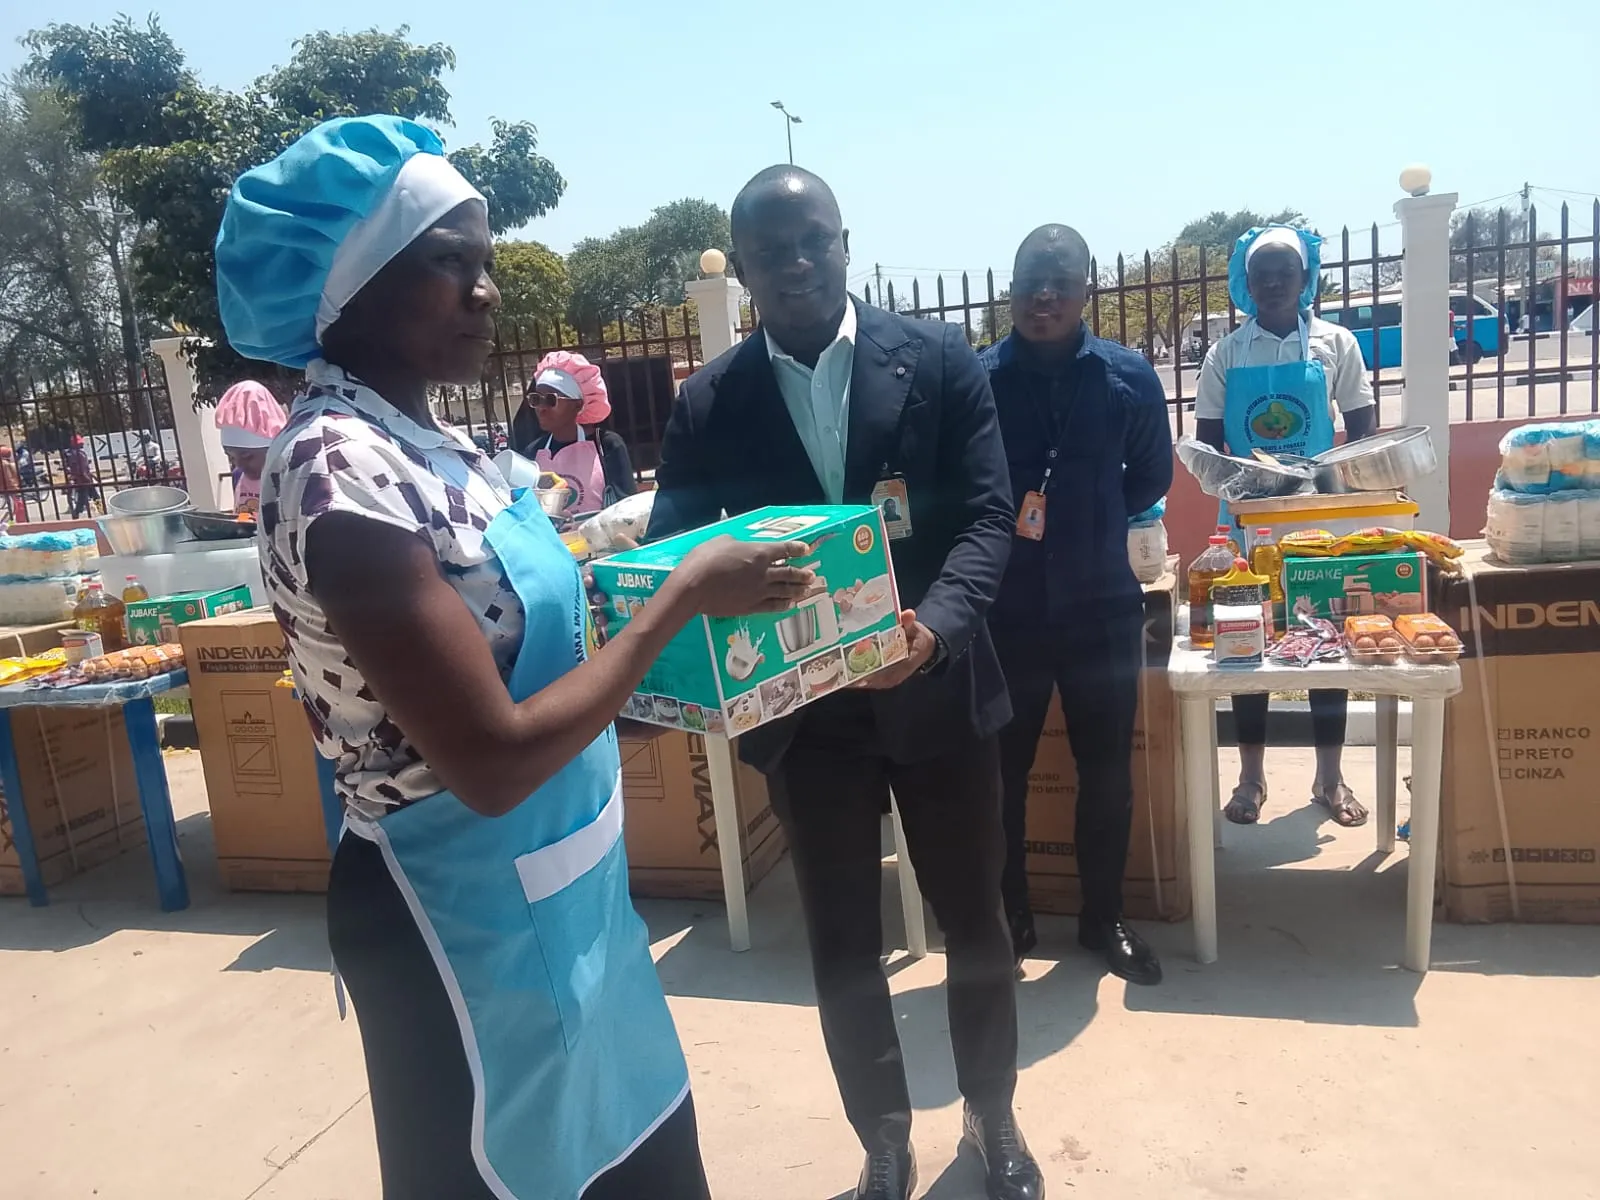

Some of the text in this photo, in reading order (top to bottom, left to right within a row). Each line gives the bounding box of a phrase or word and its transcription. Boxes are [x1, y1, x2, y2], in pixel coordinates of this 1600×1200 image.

[616, 572, 654, 589] JUBAKE
[1290, 567, 1343, 581] JUBAKE
[129, 607, 158, 618] JUBAKE
[197, 646, 288, 660] INDEMAX
[1514, 727, 1591, 740] BRANCO
[1514, 747, 1574, 760] PRETO
[1514, 767, 1565, 779] CINZA
